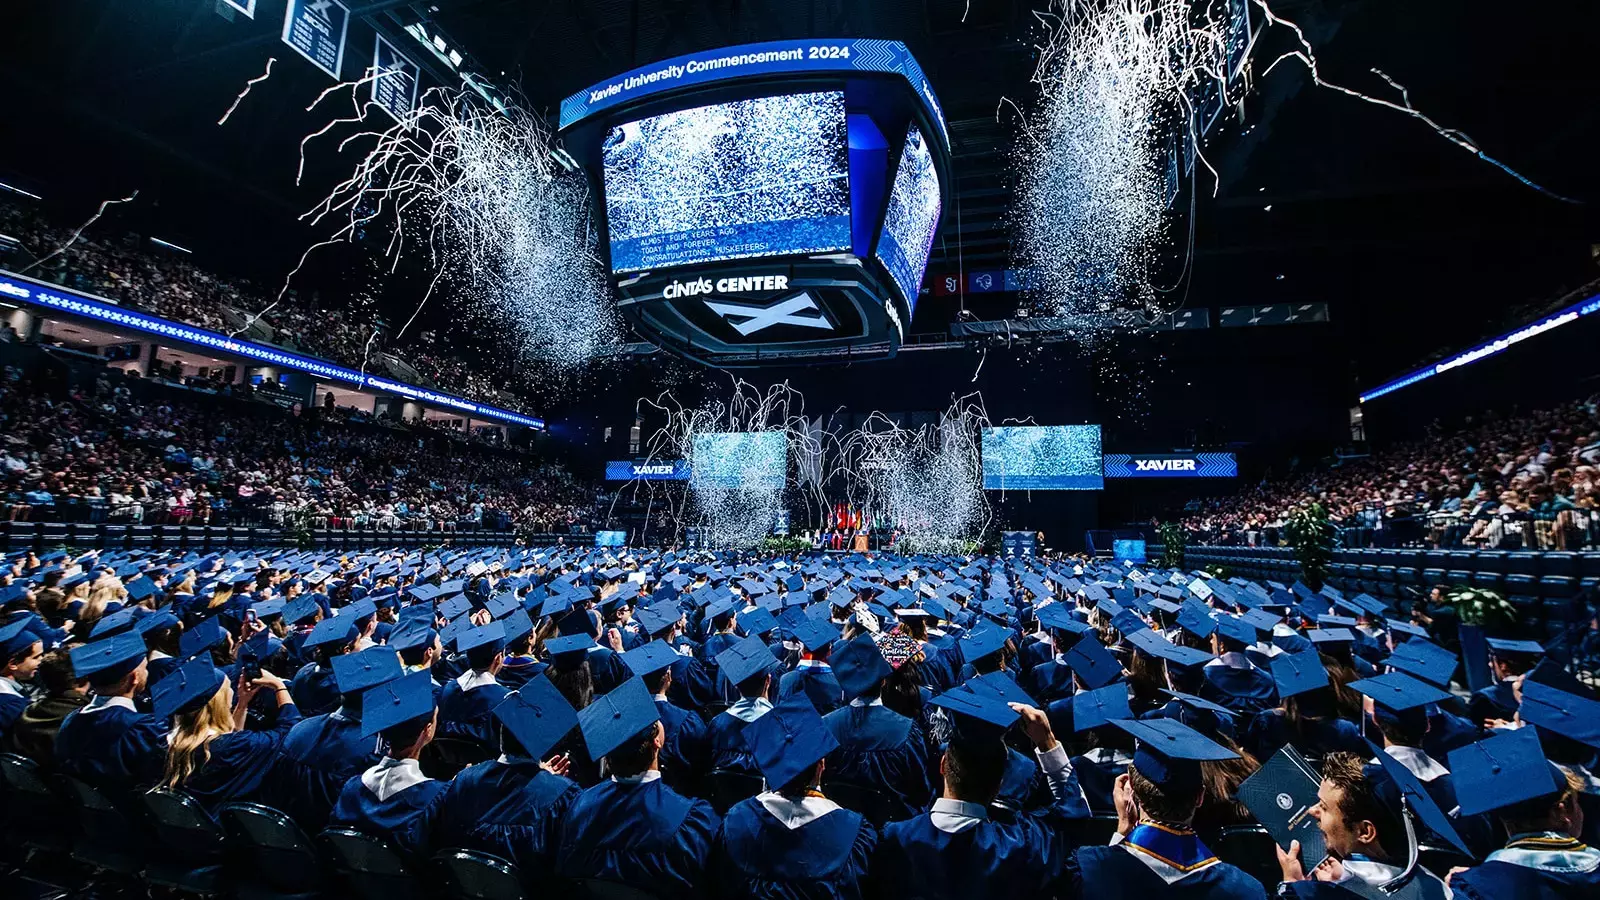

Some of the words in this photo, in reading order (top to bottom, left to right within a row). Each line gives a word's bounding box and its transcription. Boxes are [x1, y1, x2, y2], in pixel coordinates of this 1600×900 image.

[302, 11, 330, 38] NCAA
[589, 84, 624, 104] Xavier
[624, 64, 685, 90] University
[686, 48, 803, 74] Commencement
[808, 46, 850, 59] 2024
[640, 236, 665, 246] ALMOST
[669, 233, 688, 241] FOUR
[691, 230, 716, 239] YEARS
[641, 245, 661, 254] TODAY
[666, 242, 680, 251] AND
[715, 241, 769, 254] MUSKETEERS!
[716, 275, 789, 293] CENTER
[367, 377, 418, 397] Congratulations
[417, 390, 425, 398] to
[424, 392, 436, 401] Our
[435, 394, 451, 405] 2024
[632, 465, 674, 475] XAVIER
[1135, 459, 1196, 471] XAVIER
